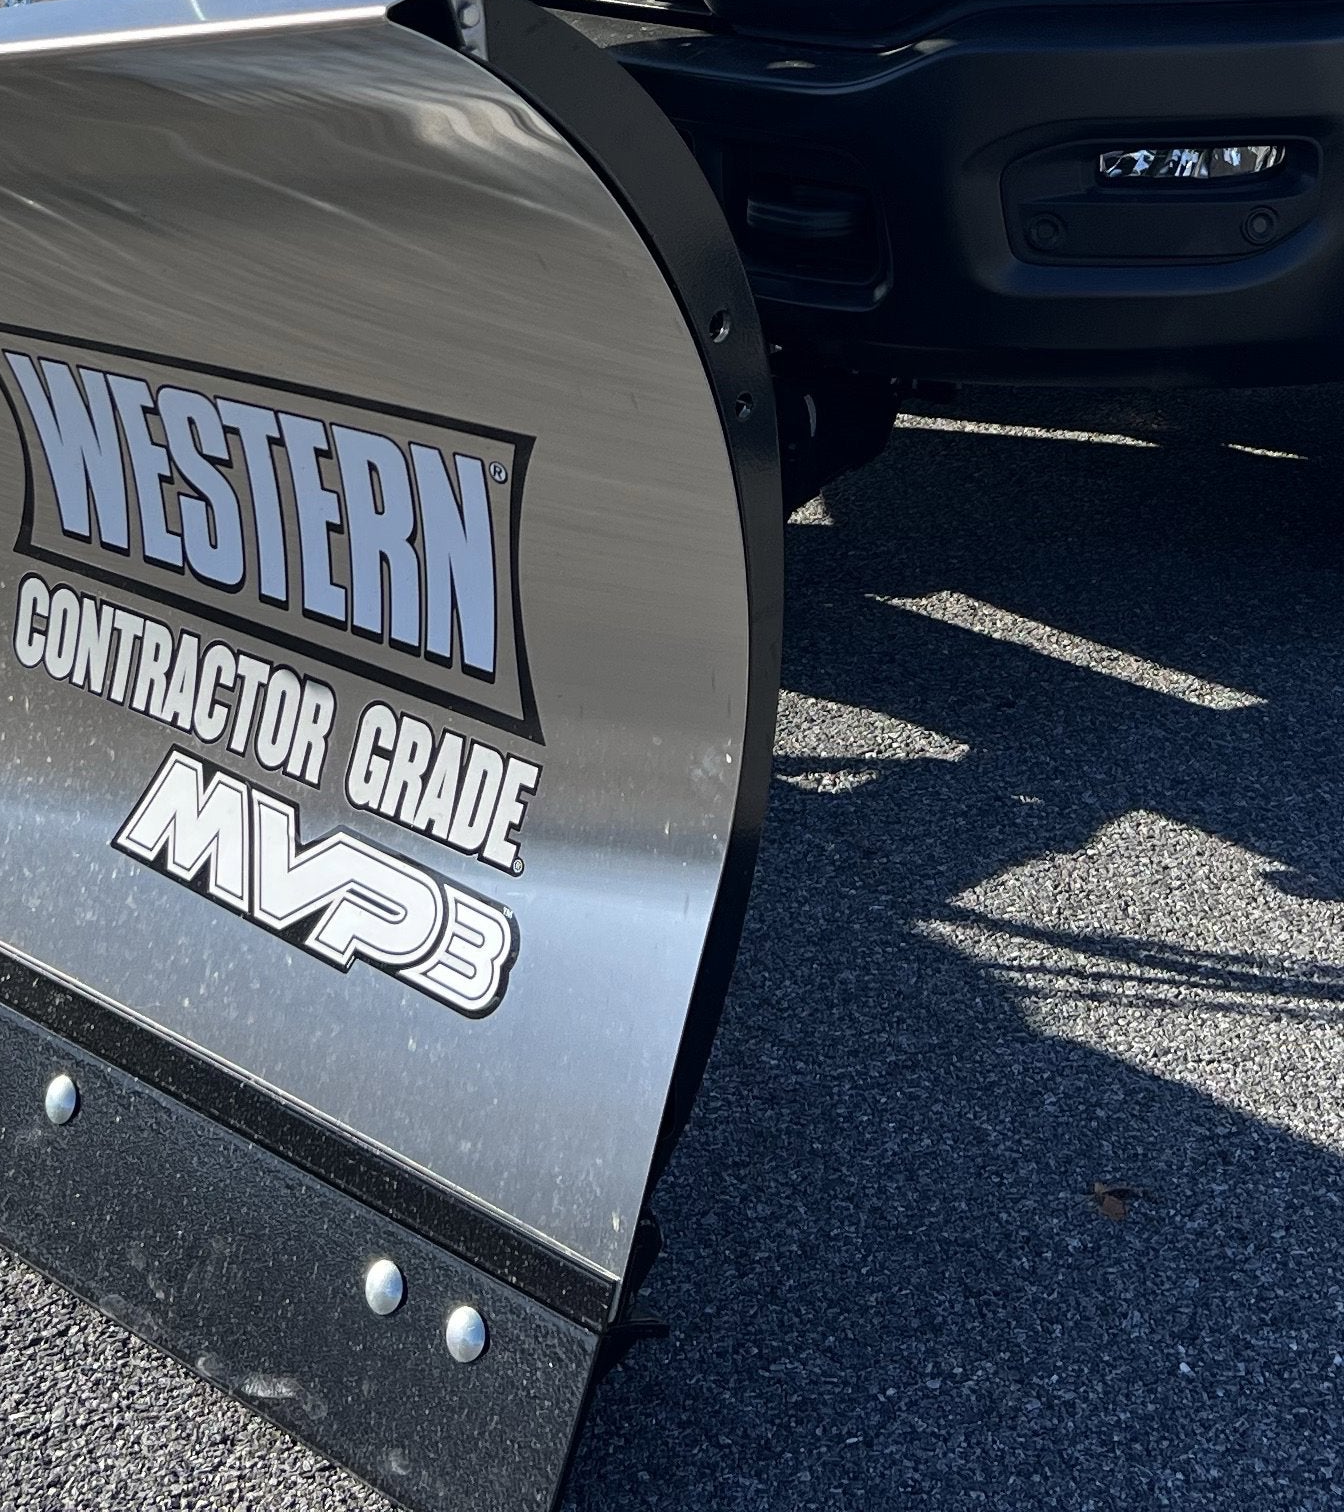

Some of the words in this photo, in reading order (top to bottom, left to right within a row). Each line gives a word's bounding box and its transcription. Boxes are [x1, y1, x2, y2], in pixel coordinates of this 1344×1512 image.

[2, 349, 498, 685] WESTERN
[13, 572, 337, 789] CONTRACTOR
[345, 700, 543, 874] GRADE
[115, 747, 517, 1015] MVP3
